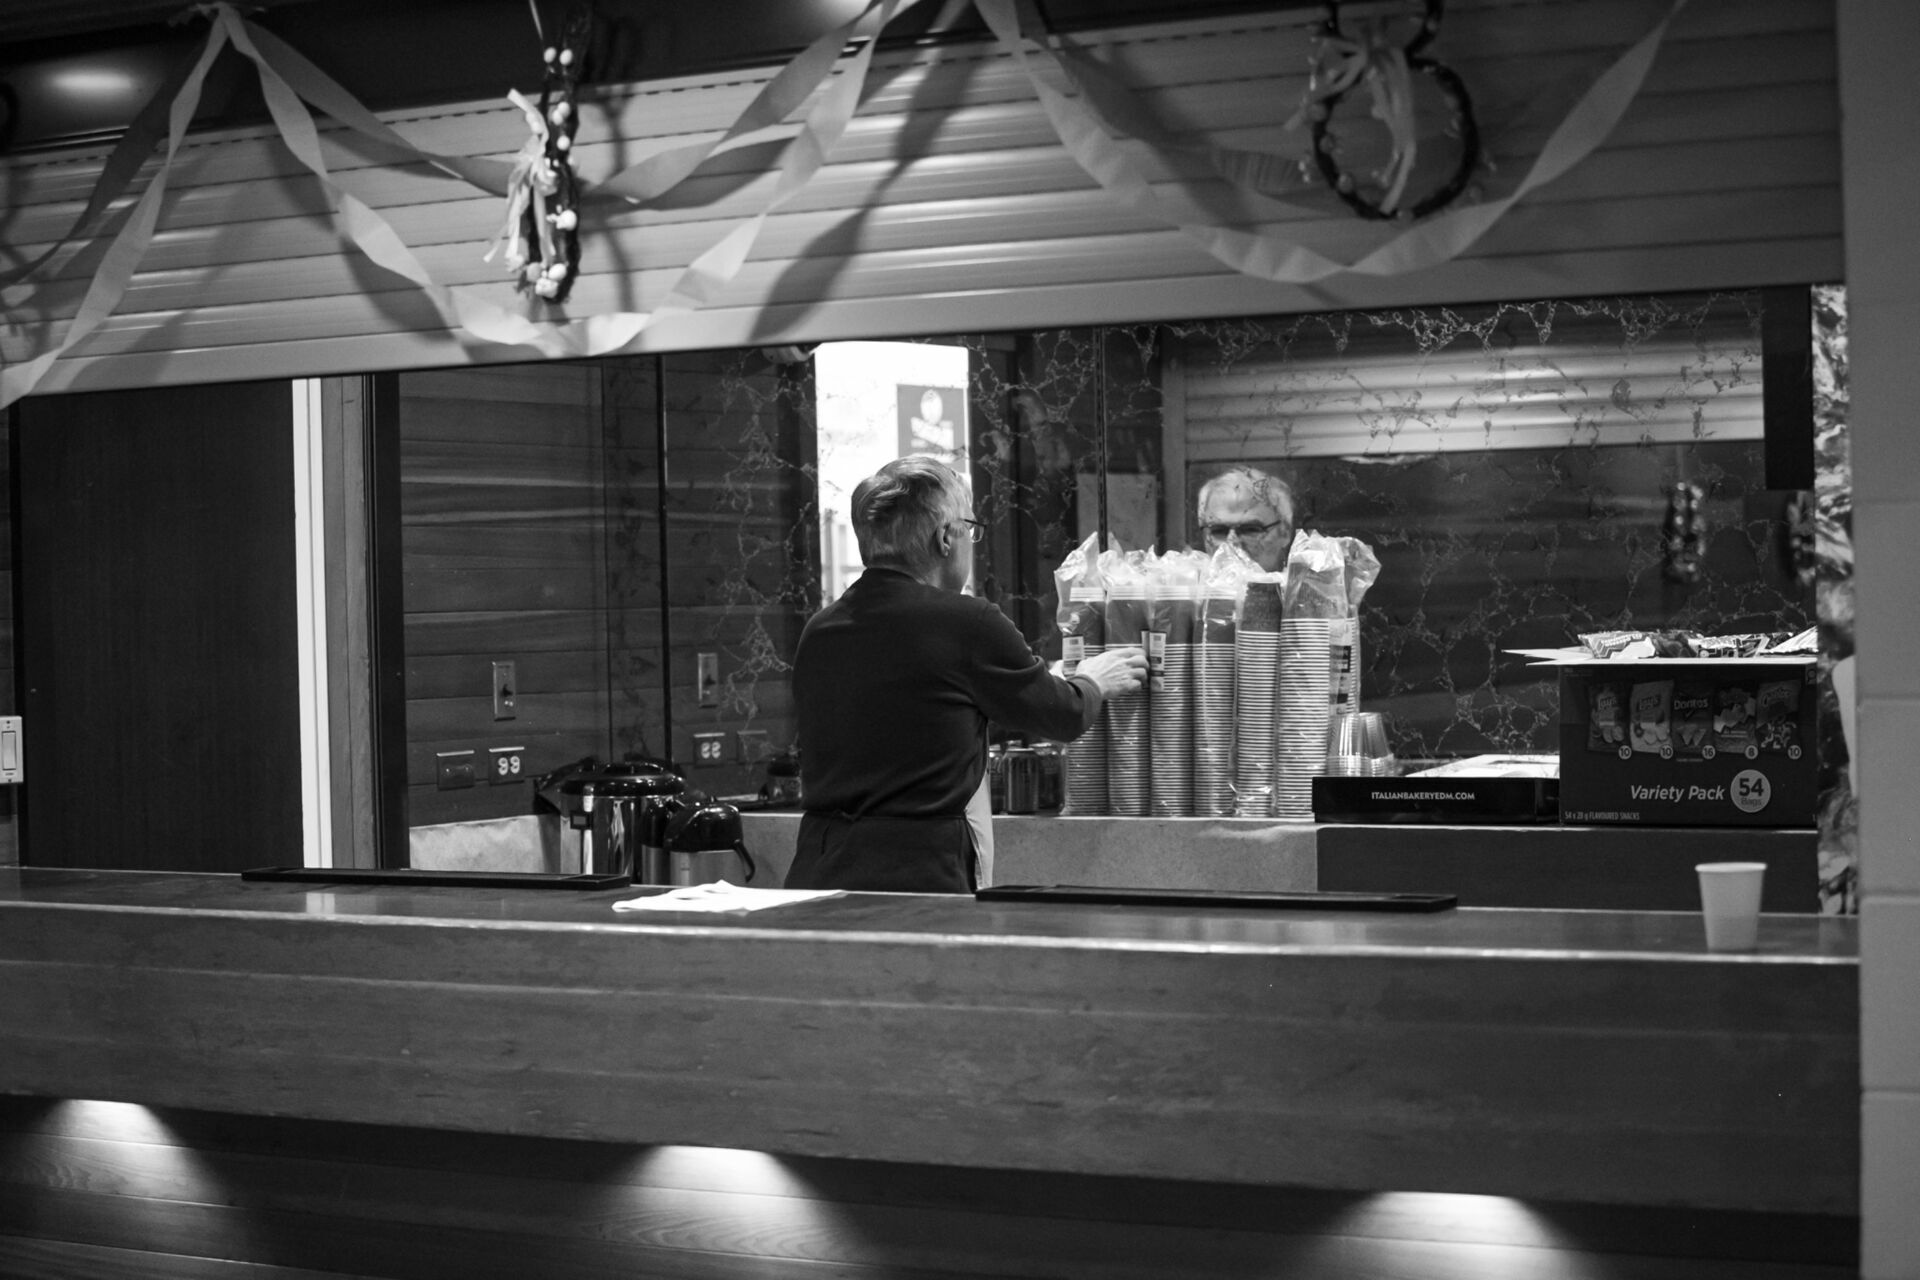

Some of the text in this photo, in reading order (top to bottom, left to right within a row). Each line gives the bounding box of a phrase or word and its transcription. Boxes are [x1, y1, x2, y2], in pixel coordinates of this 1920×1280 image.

[1673, 699, 1709, 711] Doritos
[1620, 748, 1630, 757] 10
[1662, 748, 1672, 757] 10
[1704, 748, 1714, 757] 16
[1790, 748, 1800, 757] 10
[1739, 777, 1765, 797] 54
[1371, 791, 1475, 800] ITALIANBAKERYEDM.COM
[1630, 785, 1725, 803] Variety Pack
[1620, 811, 1640, 821] SNACKS
